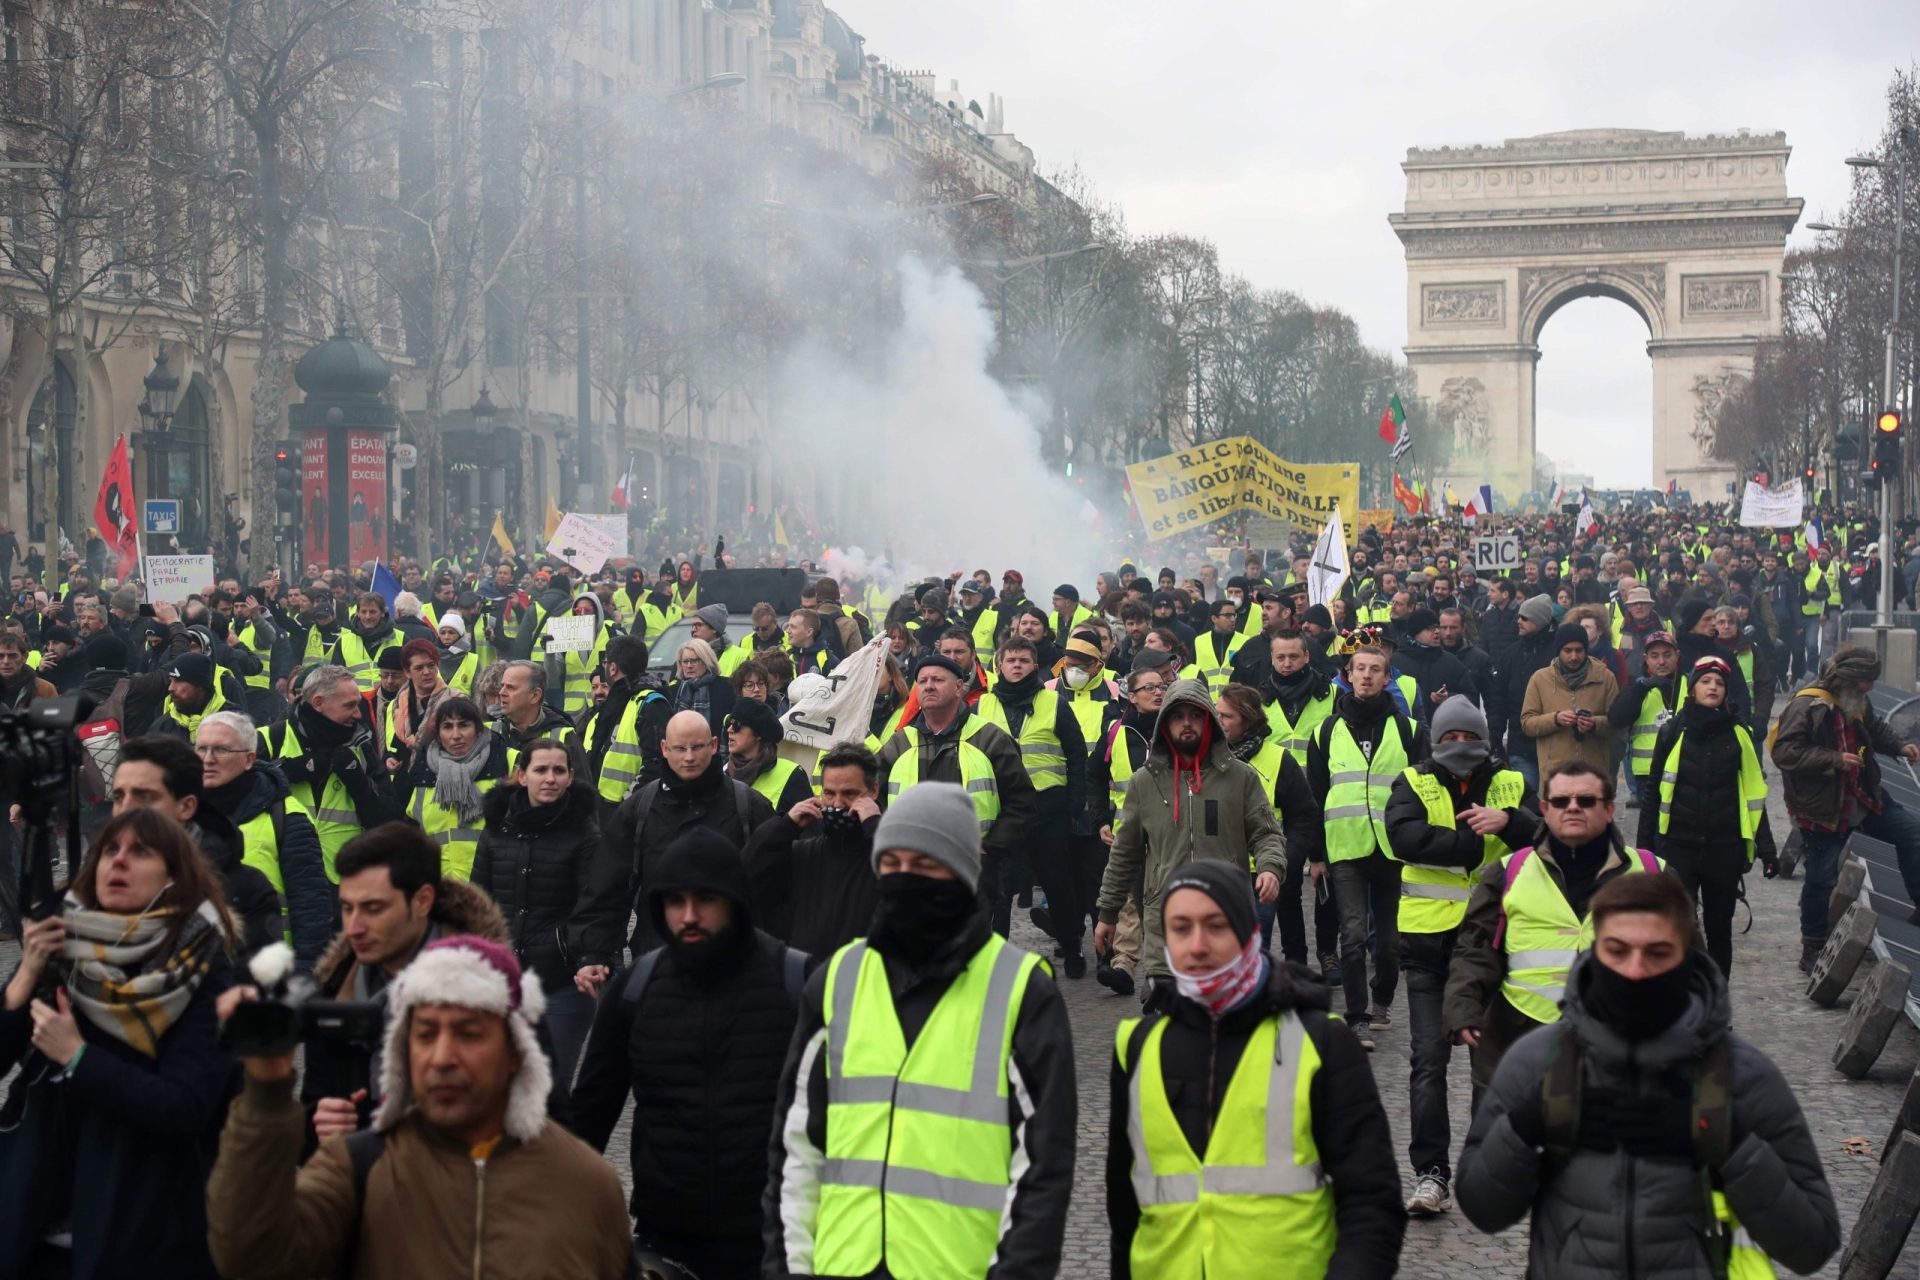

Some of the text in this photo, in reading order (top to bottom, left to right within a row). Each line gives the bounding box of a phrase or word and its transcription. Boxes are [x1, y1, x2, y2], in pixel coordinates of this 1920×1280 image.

[1236, 442, 1269, 464] pour
[1272, 462, 1306, 484] une
[148, 511, 176, 521] TAXIS
[1152, 516, 1173, 533] et
[1176, 508, 1198, 524] se
[1242, 489, 1263, 507] de
[1266, 499, 1282, 517] la
[1286, 508, 1352, 539] DETE
[1478, 540, 1516, 565] RIC
